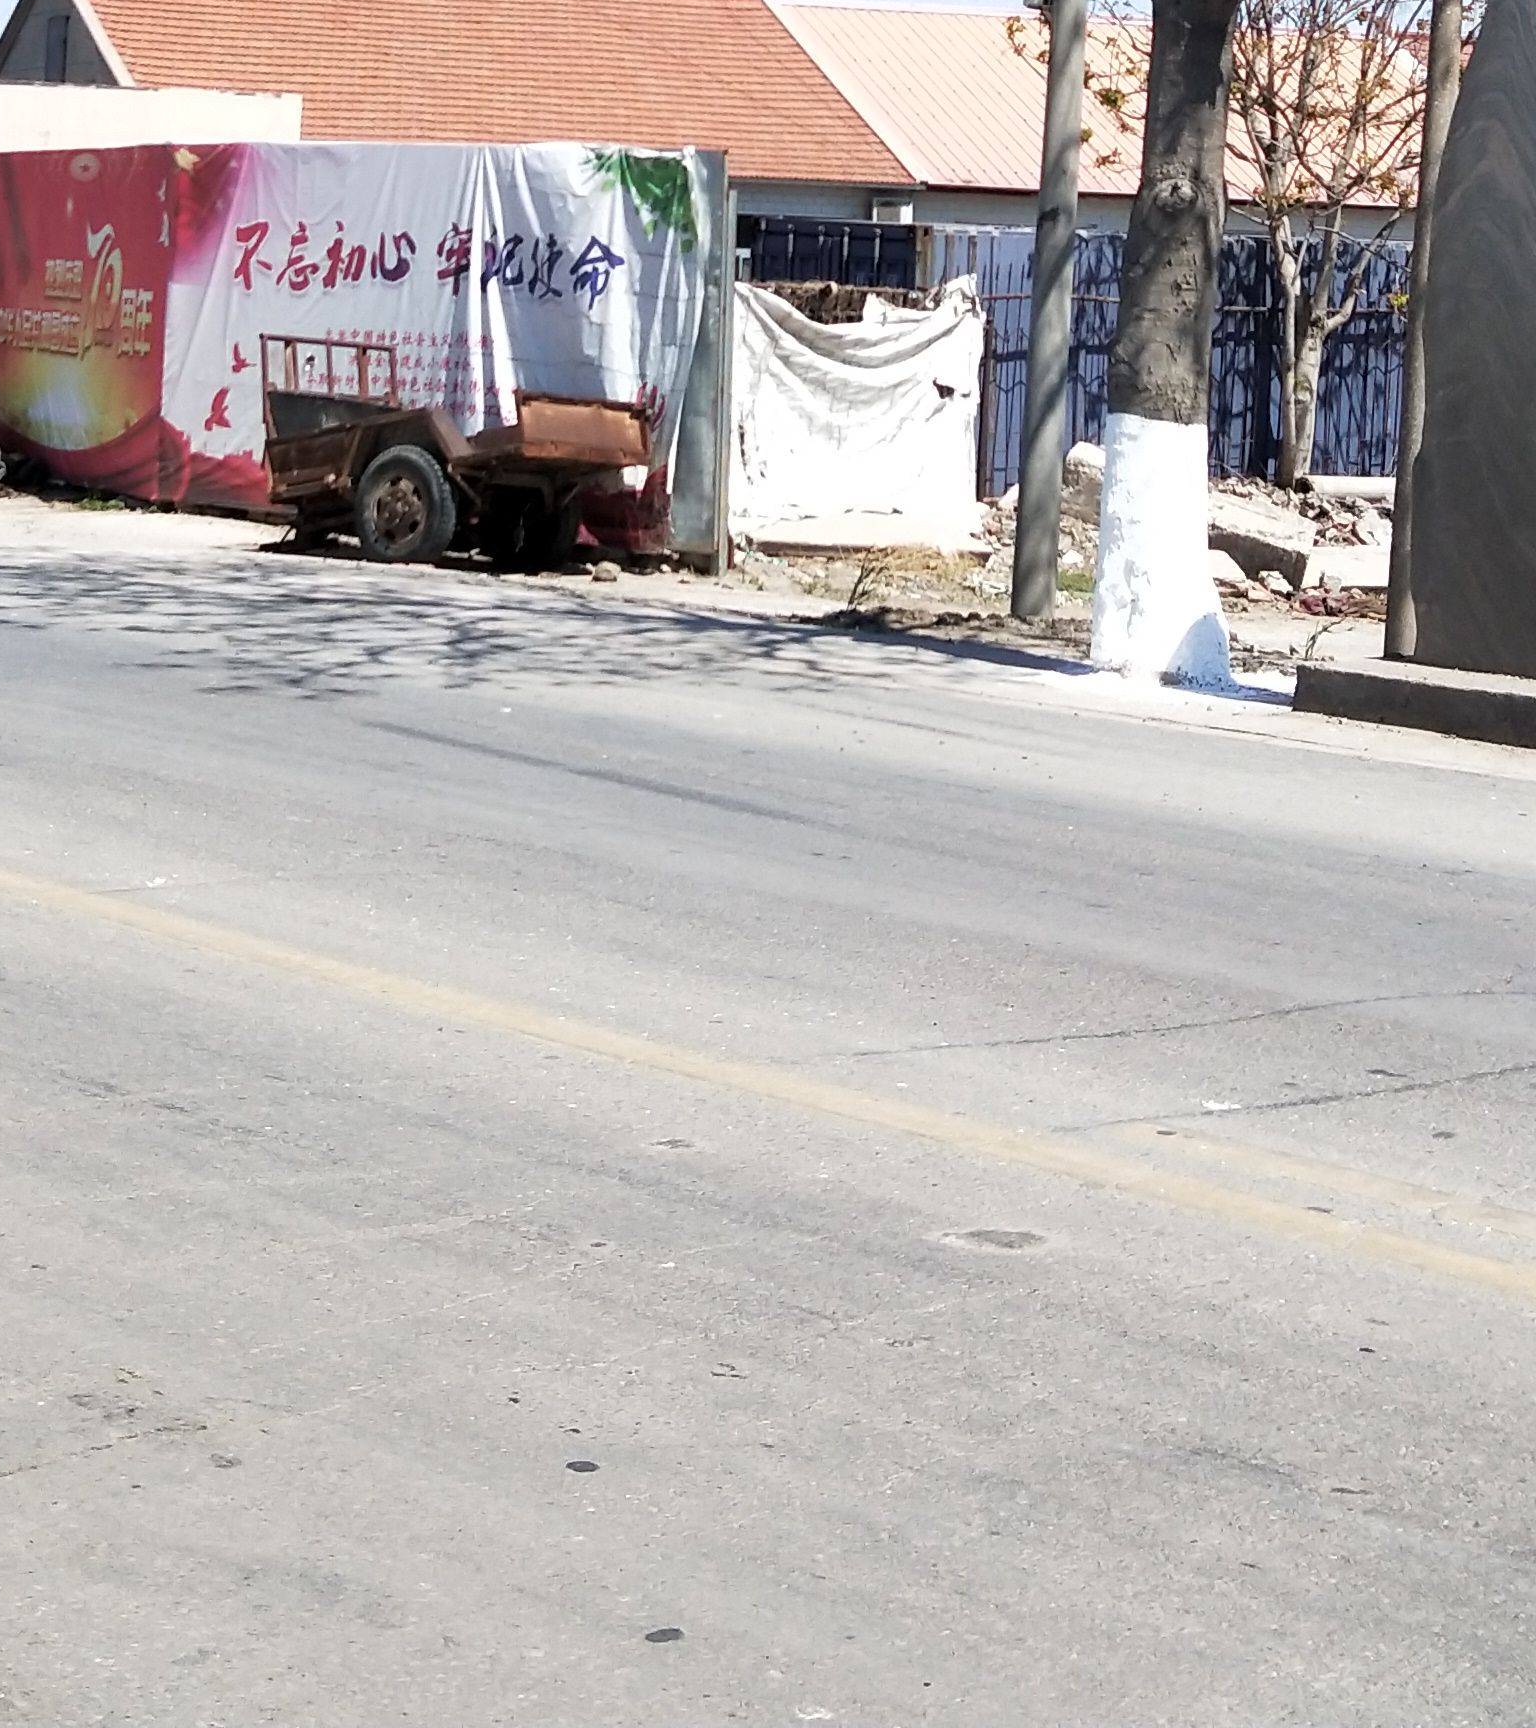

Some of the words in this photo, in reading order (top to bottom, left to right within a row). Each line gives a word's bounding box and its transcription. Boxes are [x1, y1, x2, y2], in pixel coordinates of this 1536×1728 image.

[233, 221, 417, 292] 不忘初心
[436, 221, 625, 310] 牢记使命
[117, 287, 154, 358] 周年
